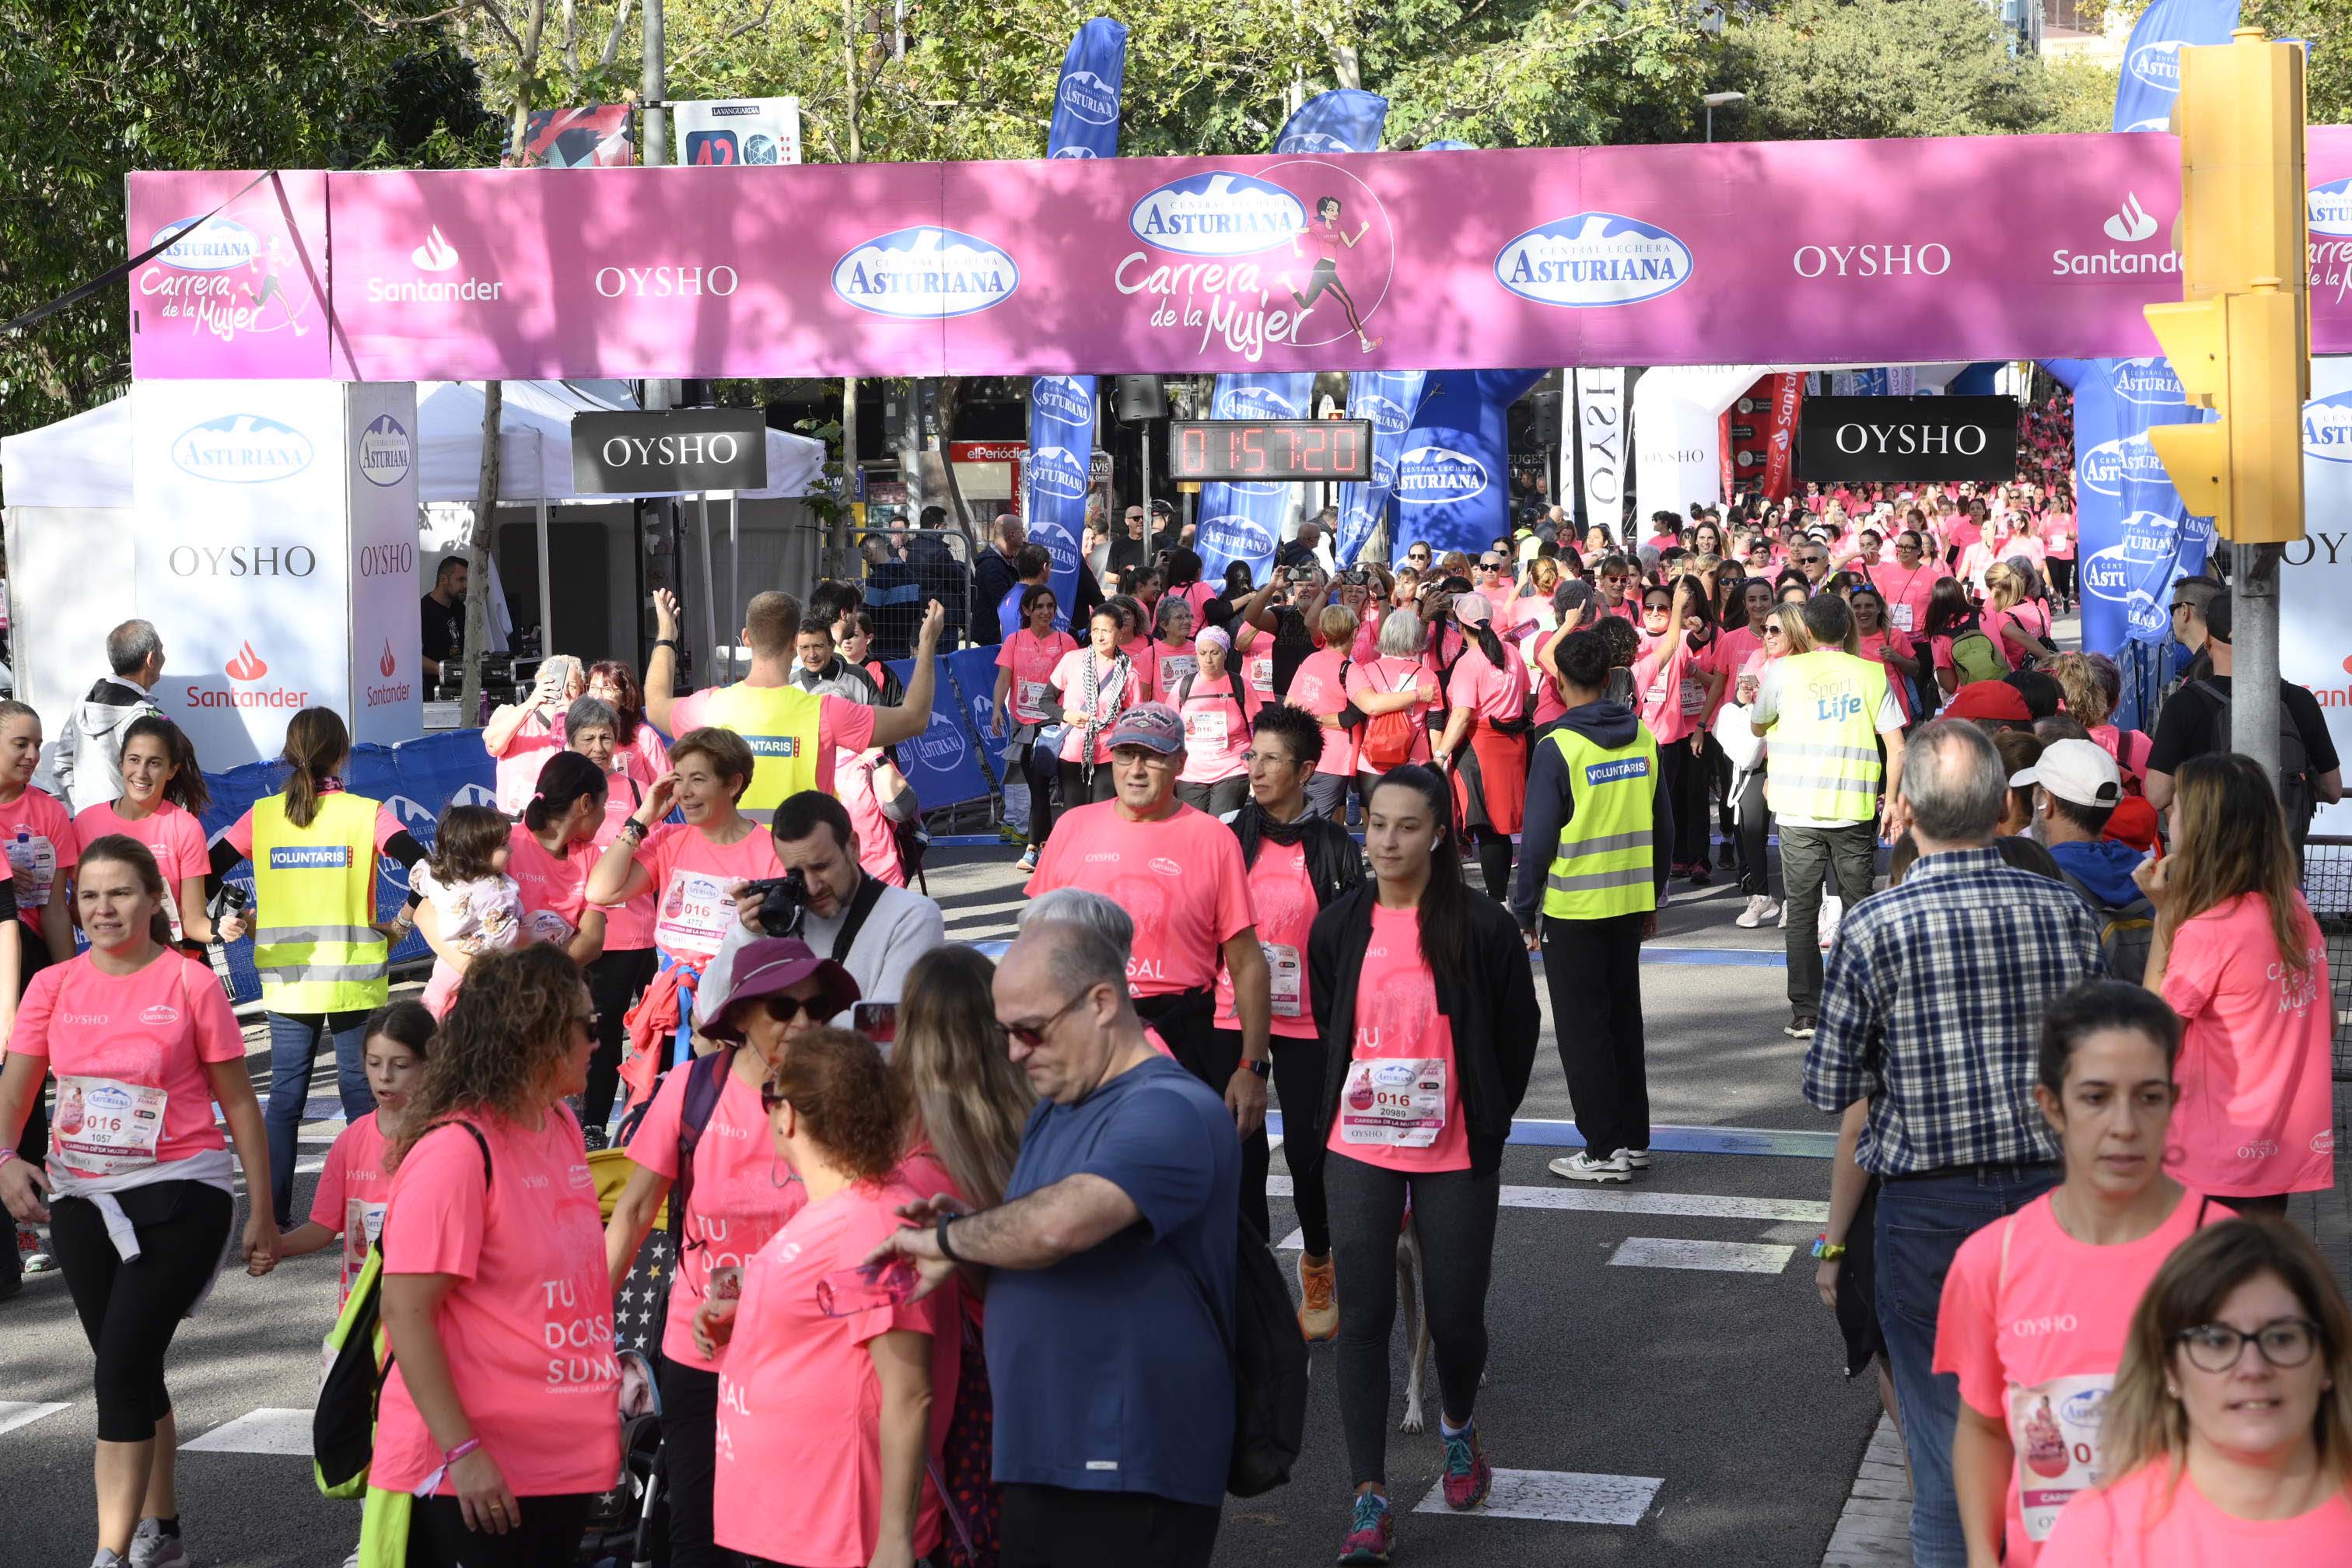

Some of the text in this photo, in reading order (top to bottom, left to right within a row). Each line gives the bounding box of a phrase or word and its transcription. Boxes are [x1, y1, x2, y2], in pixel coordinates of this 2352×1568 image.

[720, 106, 760, 115] VANGUARDIA
[1143, 203, 1294, 235] ASTURIANA
[1540, 243, 1671, 255] CENTRAL LECHERA
[1794, 243, 1951, 277] OYSHO
[1115, 251, 1262, 296] Carrera
[1510, 249, 1678, 284] ASTURIANA
[2053, 249, 2184, 275] Santand
[140, 267, 231, 296] Carrera
[595, 266, 739, 298] OYSHO
[847, 261, 1005, 294] ASTURIANA
[2326, 265, 2339, 286] la
[368, 278, 503, 302] Santander
[162, 294, 265, 341] de la Mujer
[1150, 291, 1314, 362] de la Mujer
[2116, 369, 2186, 394] ASTURIA
[603, 434, 737, 467] OYSHO
[1836, 423, 1986, 457] OYSHO
[184, 441, 304, 467] ASTURIANA
[362, 441, 408, 469] ASTURIANA
[1393, 473, 1481, 491] ASTURIANA
[1203, 524, 1268, 554] ASTURIANA
[169, 545, 317, 577] OYSHO
[360, 542, 412, 577] OYSHO
[187, 685, 309, 709] Santander
[367, 682, 411, 708] Santander
[1818, 692, 1861, 723] Life
[747, 740, 791, 752] NTARIS
[1587, 761, 1646, 781] VOLUNTARIS
[271, 851, 345, 864] VOLUNTARIS
[684, 903, 710, 917] 016
[687, 919, 703, 927] 4772
[1125, 957, 1164, 979] SAL
[63, 1013, 108, 1025] OYSHO
[90, 1094, 128, 1106] ASTURIANA
[136, 1097, 159, 1106] SUMA
[1377, 1092, 1410, 1106] 016
[87, 1115, 121, 1132] 016
[1381, 1108, 1406, 1118] 20989
[91, 1133, 112, 1143] 1057
[1351, 1130, 1382, 1139] OYSHO
[65, 1143, 89, 1152] CARRERA
[696, 1214, 727, 1242] TU
[543, 1279, 576, 1310] TU
[546, 1353, 621, 1384] SUM
